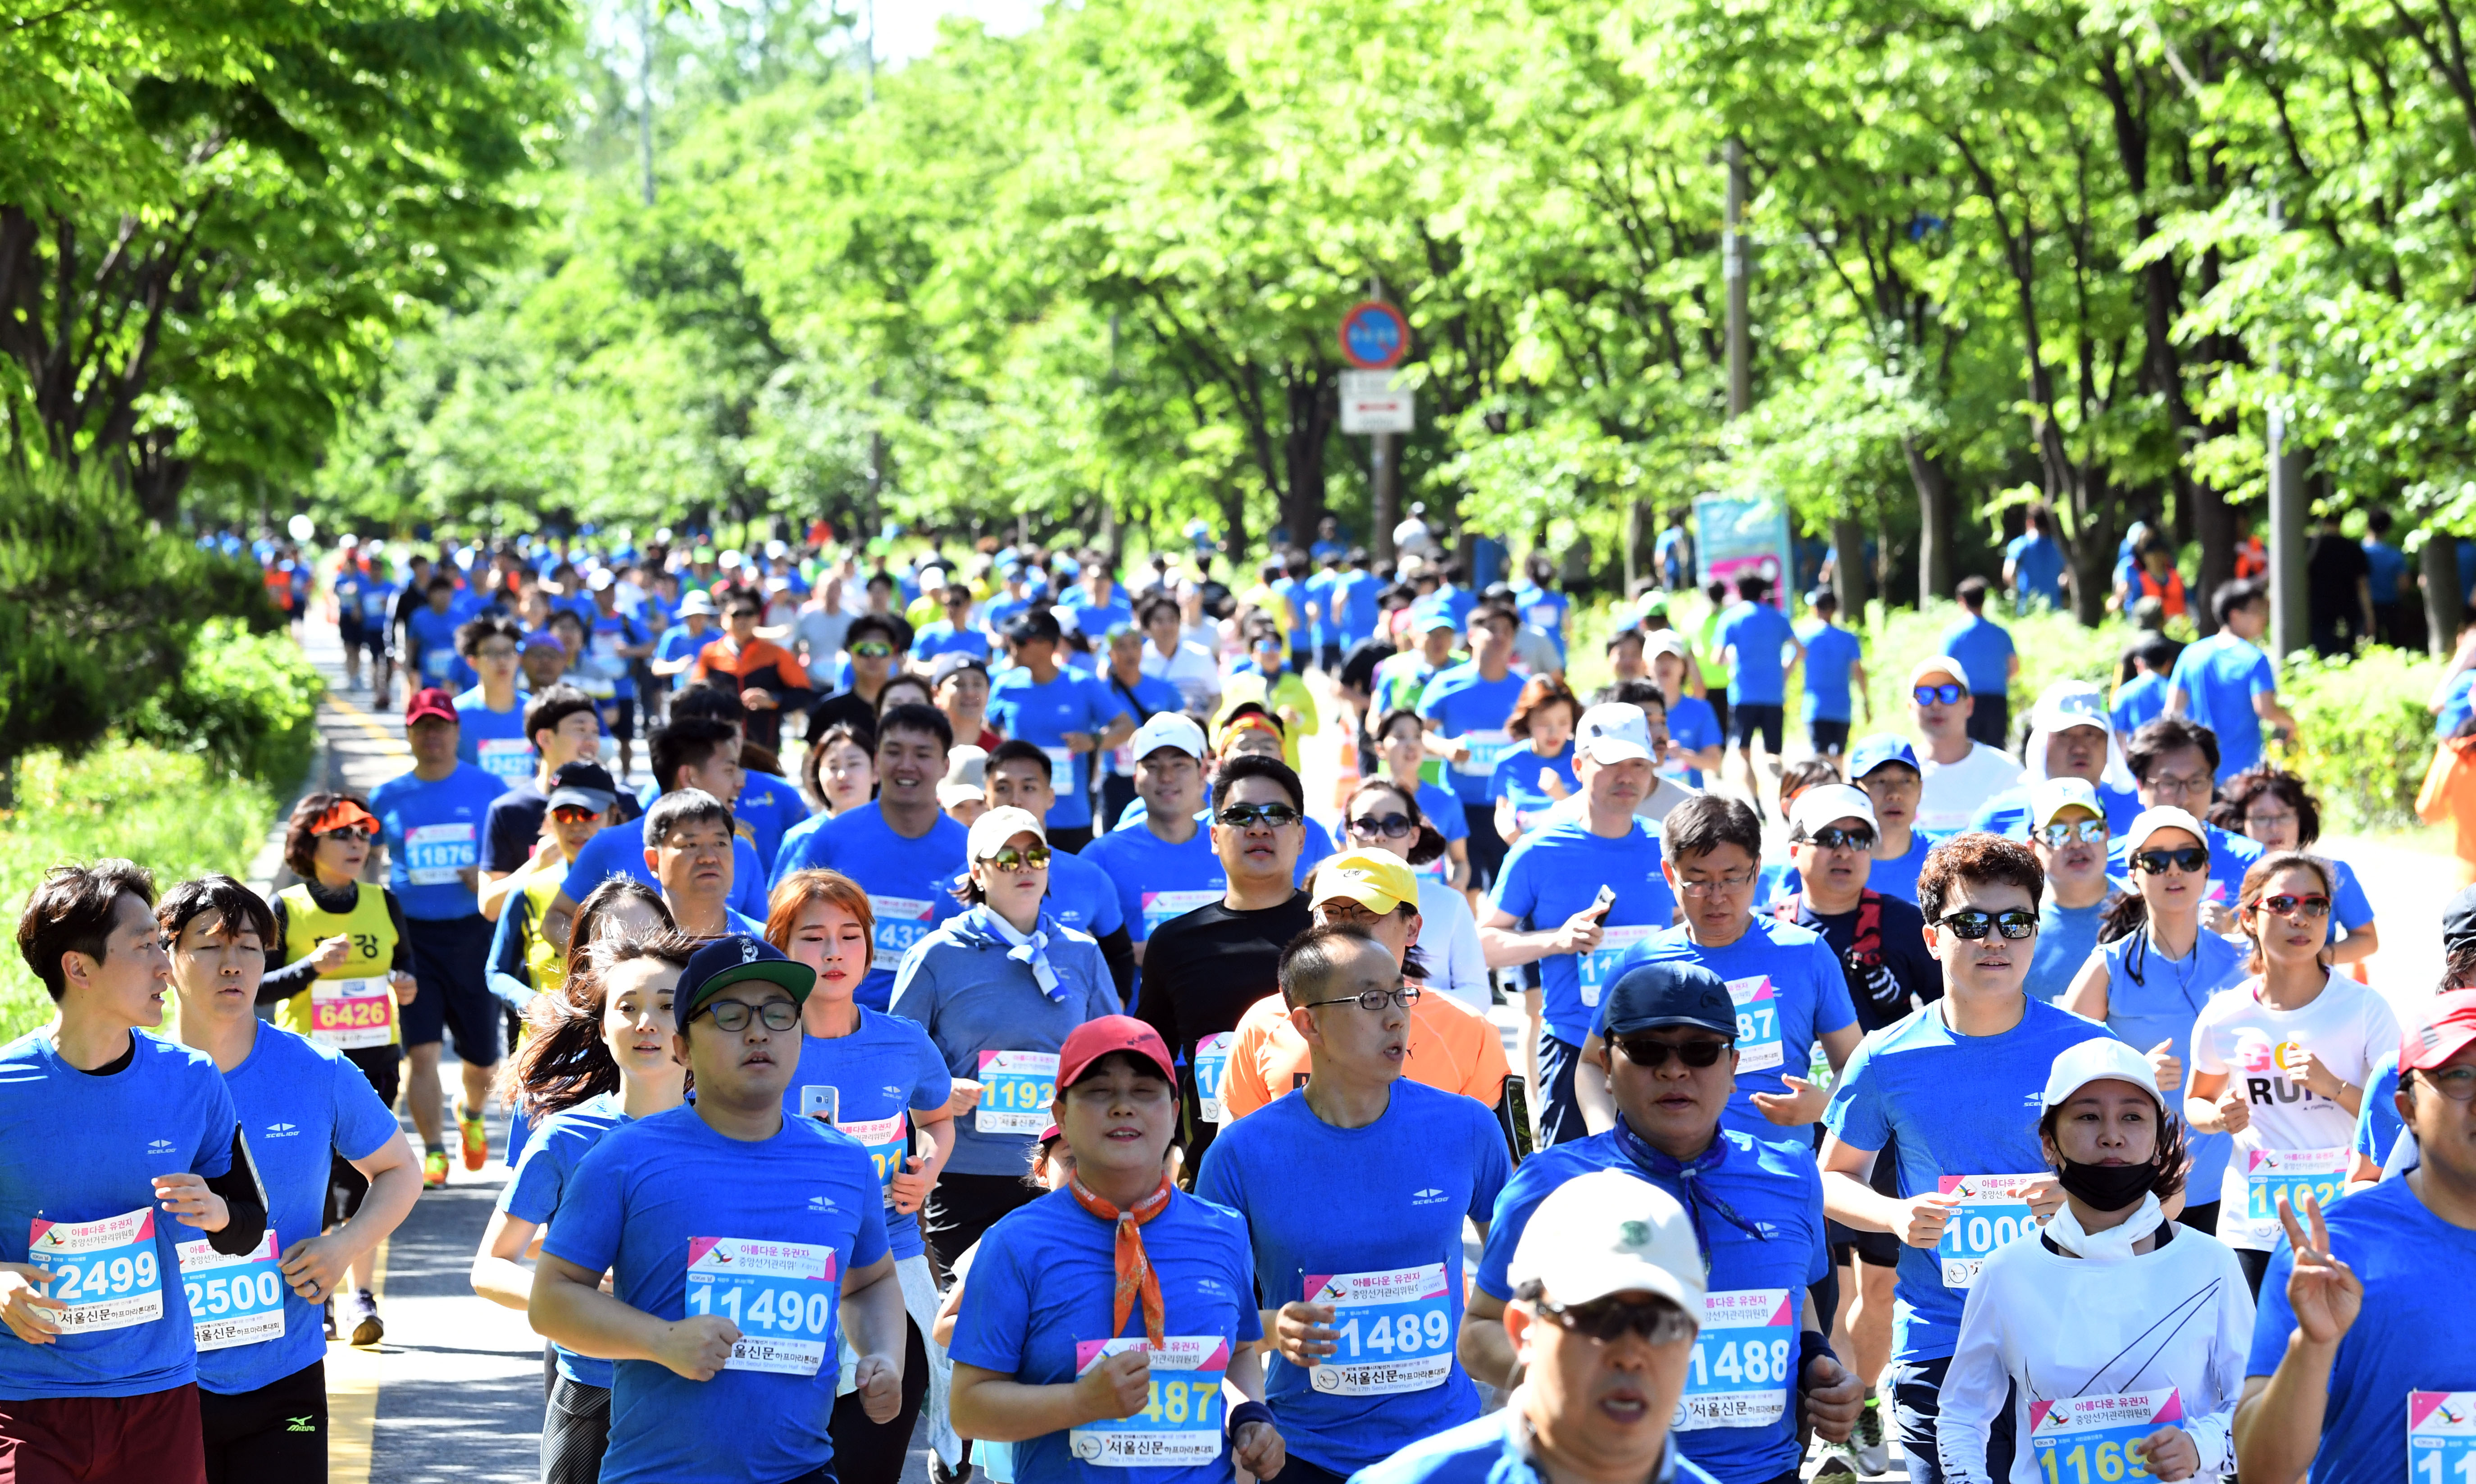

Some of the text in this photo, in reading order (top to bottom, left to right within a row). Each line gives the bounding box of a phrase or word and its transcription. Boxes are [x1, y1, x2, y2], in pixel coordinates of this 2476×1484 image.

[407, 845, 475, 868] 11876
[320, 1001, 386, 1027] 6426
[2247, 1076, 2332, 1106] RU
[871, 1122, 892, 1132] 유권자
[1411, 1197, 1450, 1206] SCELIDO
[71, 1218, 133, 1237] 아름다운 유권자
[71, 1229, 135, 1248] 중앙선거관리위원회
[741, 1244, 810, 1258] 아름다운 유권자
[739, 1256, 797, 1271] 중앙선거관리위
[38, 1251, 157, 1299] 12499
[1352, 1276, 1391, 1288] 아름다운
[1394, 1271, 1421, 1284] 유권자
[1739, 1295, 1767, 1306] 유권자
[61, 1303, 157, 1325] 서울신문 하프마라톤대회
[690, 1285, 828, 1334] 11490
[237, 1322, 280, 1336] 하프마라톤대회
[1171, 1342, 1199, 1352] 유권자
[1689, 1339, 1789, 1385] 1488
[1345, 1367, 1446, 1385] 서울신문 하프마라톤대회
[1693, 1402, 1747, 1417] 서울신문
[2075, 1396, 2149, 1412] 아름다운 유권자
[2075, 1407, 2152, 1426] 중앙선거관리위원회
[1108, 1440, 1214, 1455] 서울신문 하프마라톤대회
